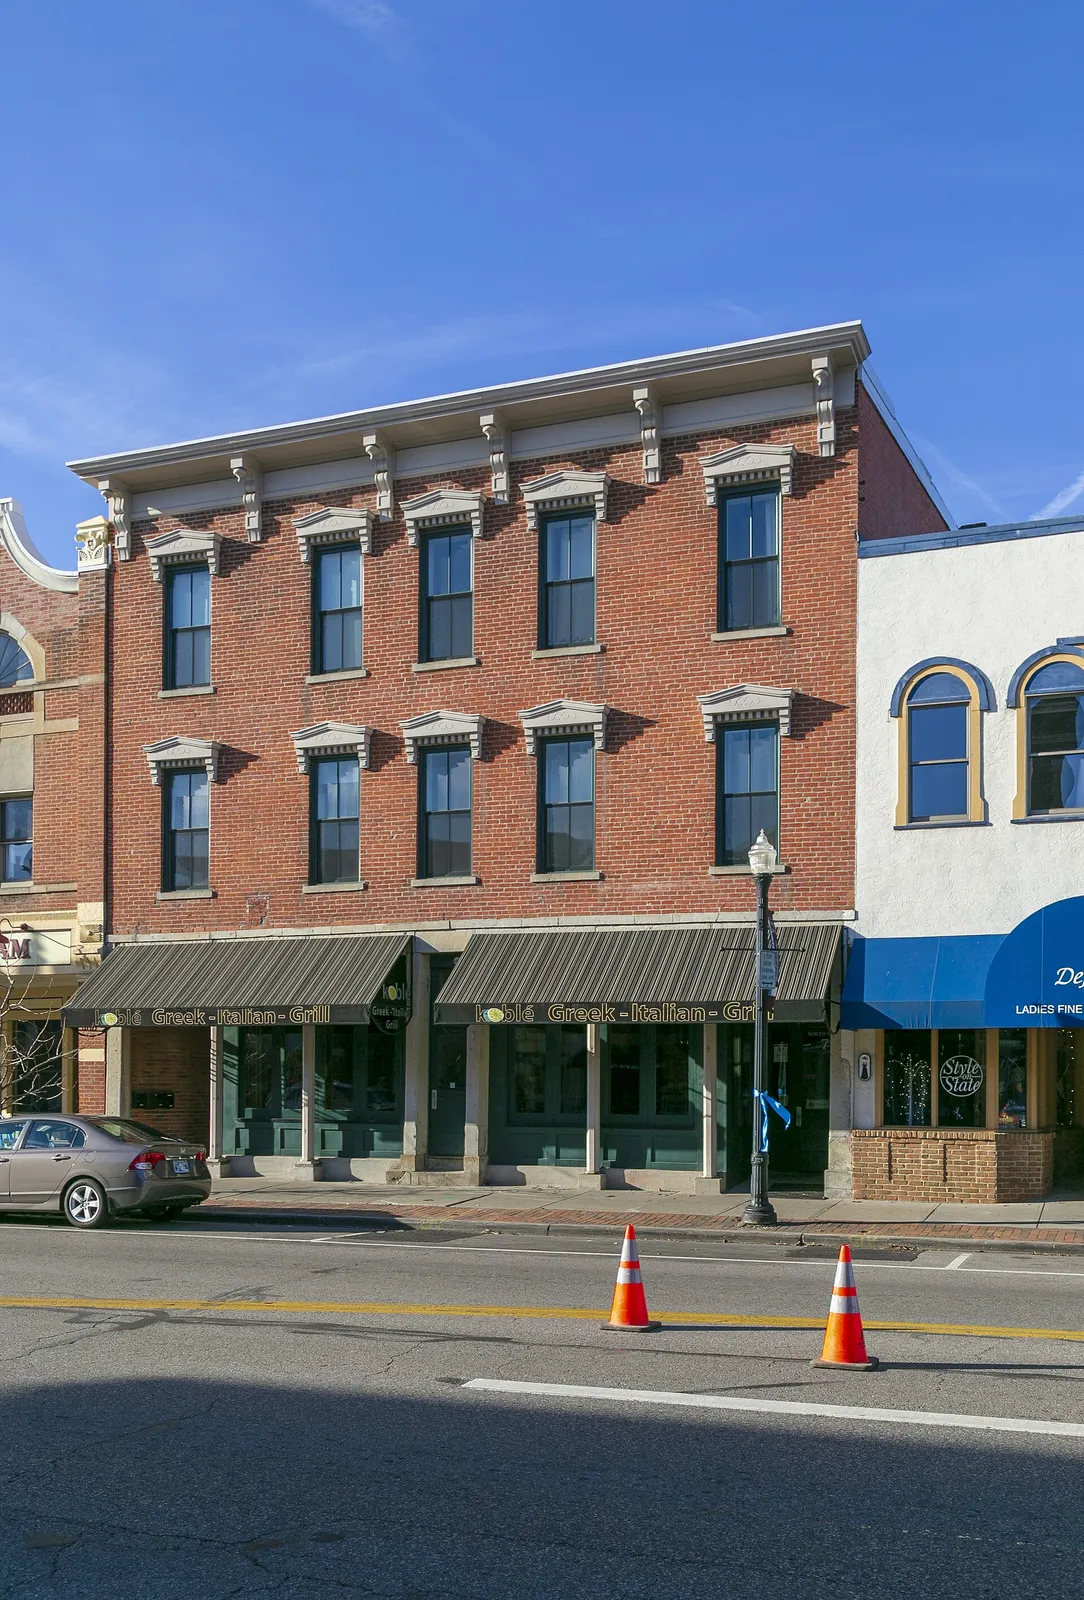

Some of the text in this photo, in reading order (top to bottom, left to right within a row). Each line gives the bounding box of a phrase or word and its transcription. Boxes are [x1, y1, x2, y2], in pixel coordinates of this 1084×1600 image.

[1054, 967, 1084, 989] De
[151, 1008, 206, 1025] Greek
[289, 1004, 331, 1024] Grill
[547, 1003, 616, 1022] Greek
[1015, 1004, 1083, 1015] LADIES FINE
[943, 1058, 980, 1077] Style
[945, 1075, 981, 1092] State
